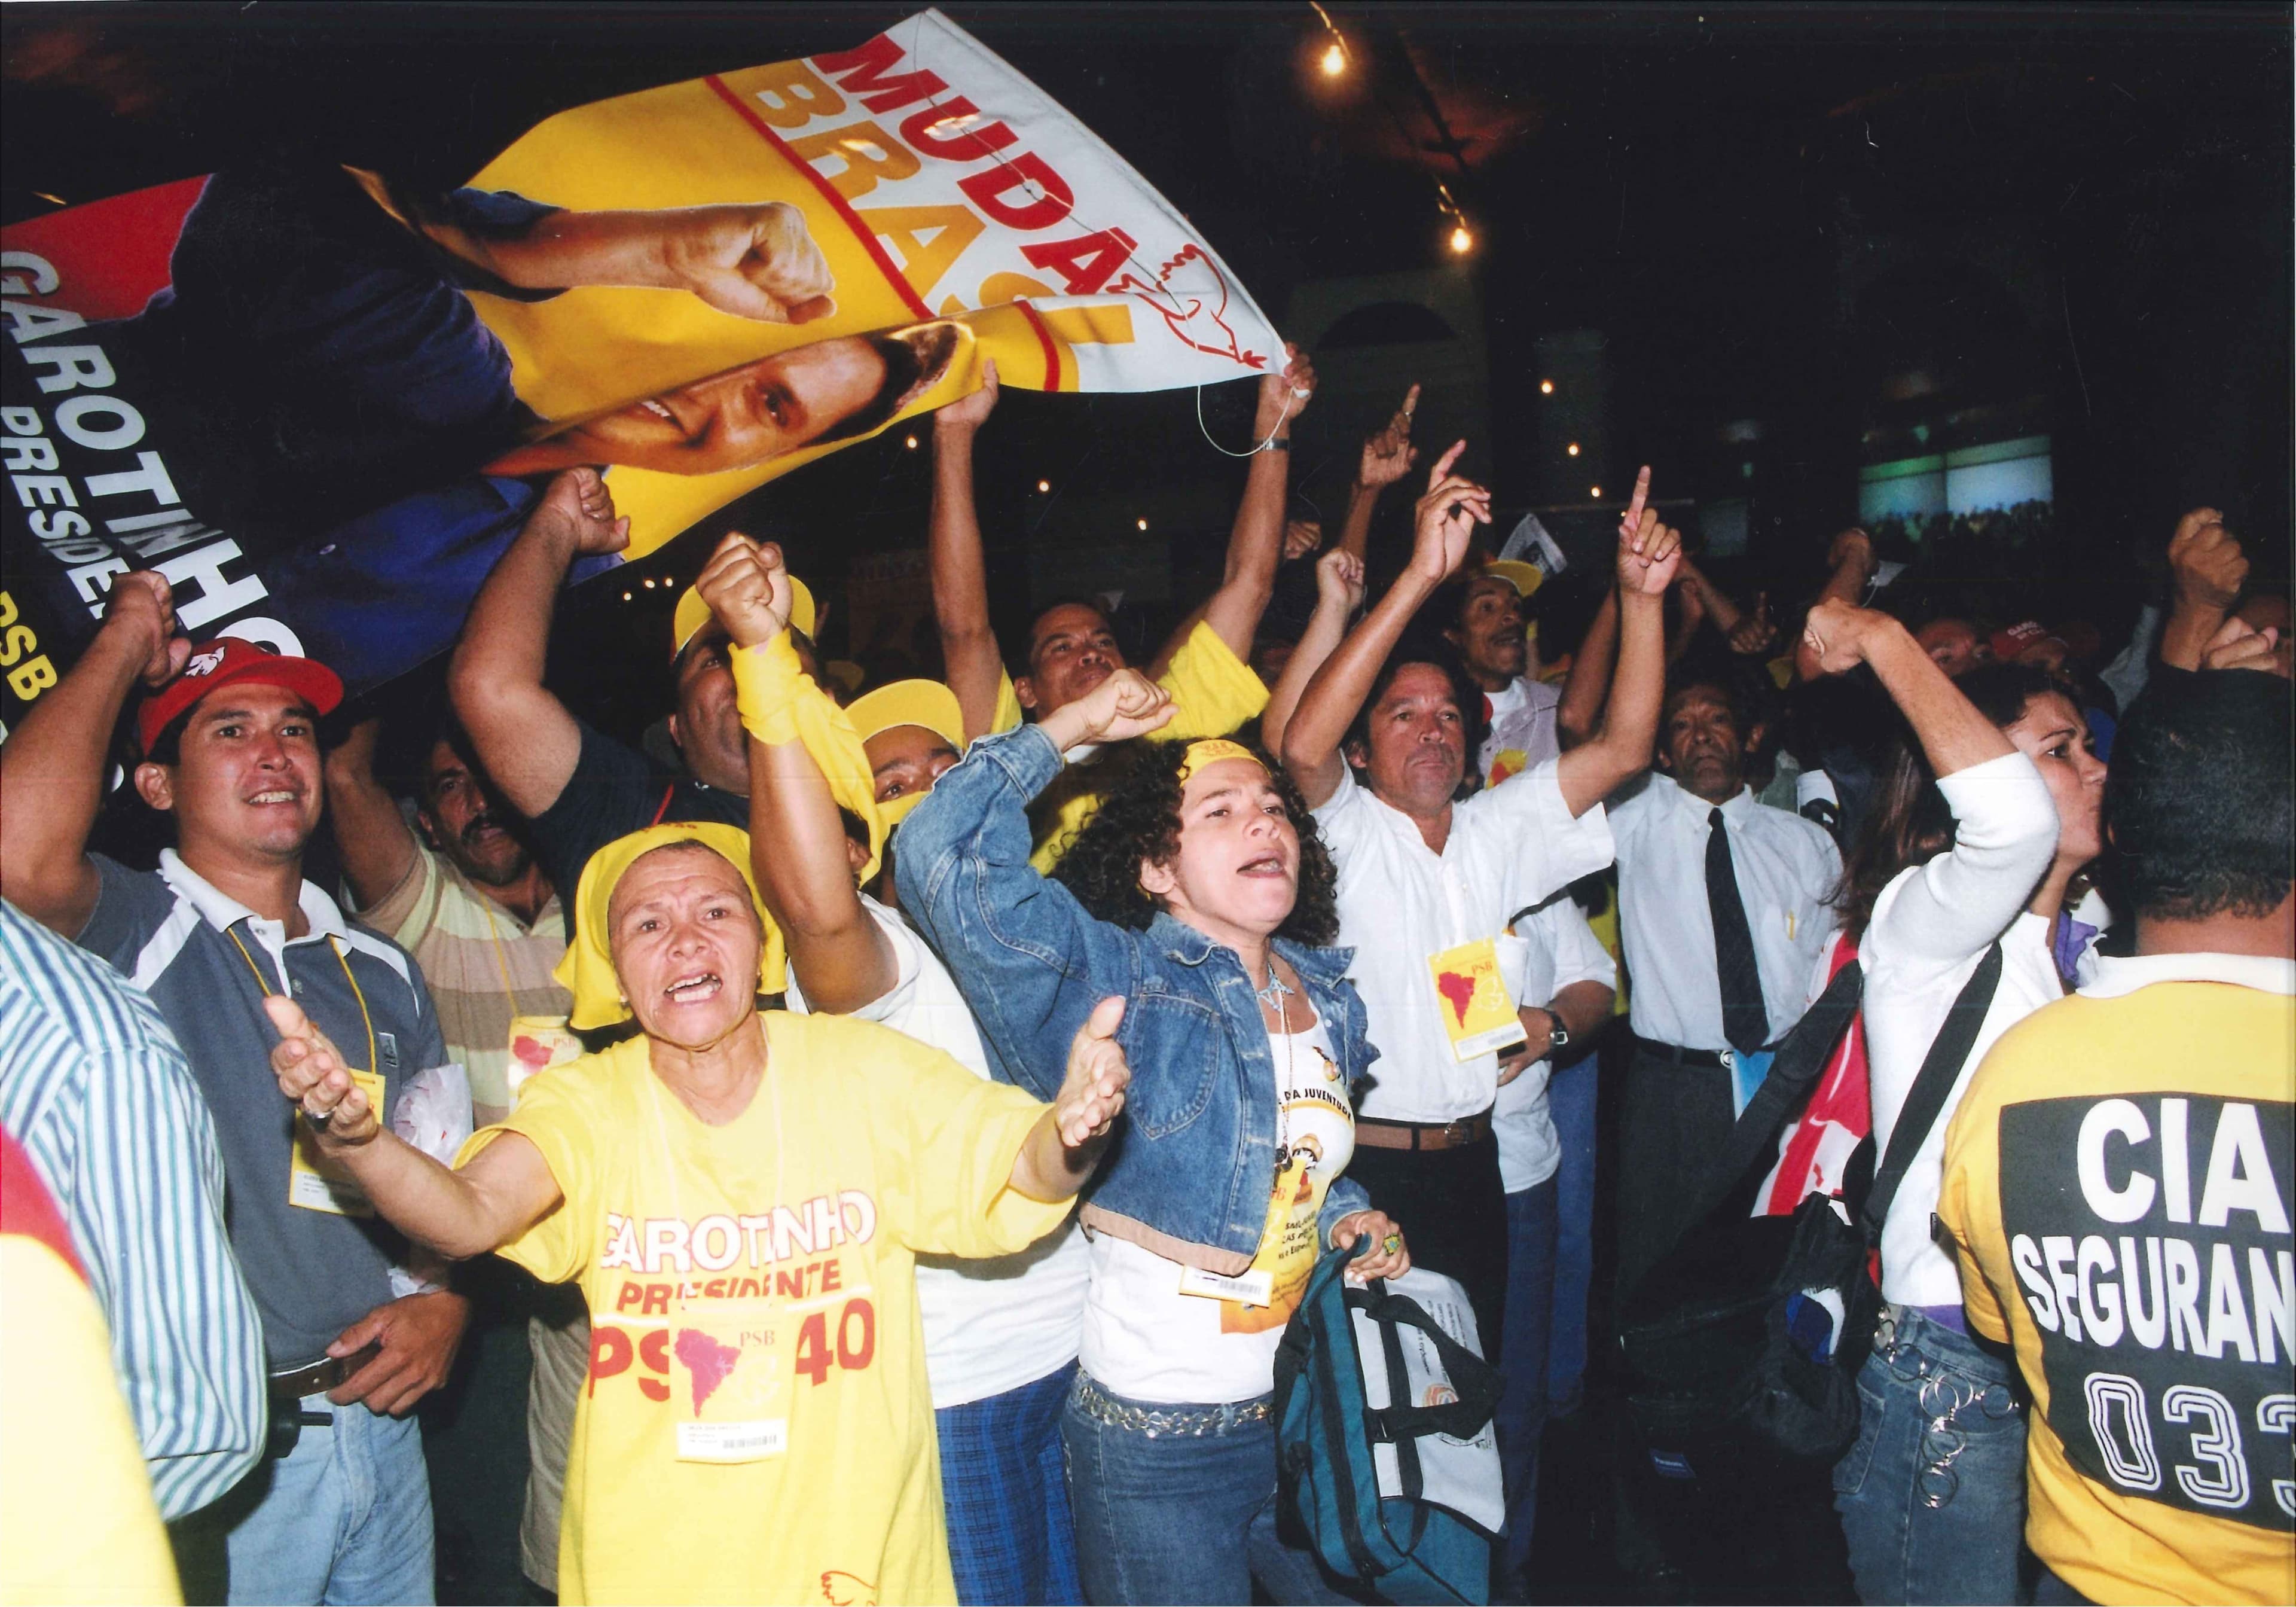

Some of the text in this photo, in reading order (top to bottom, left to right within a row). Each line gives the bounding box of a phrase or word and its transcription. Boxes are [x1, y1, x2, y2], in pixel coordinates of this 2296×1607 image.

[811, 32, 1138, 296] MUDA
[1, 407, 132, 620] PRESIDE
[1284, 1090, 1300, 1100] DA
[2077, 1098, 2291, 1234] CIA
[588, 1298, 875, 1402] PS 40
[740, 1330, 775, 1347] PSB
